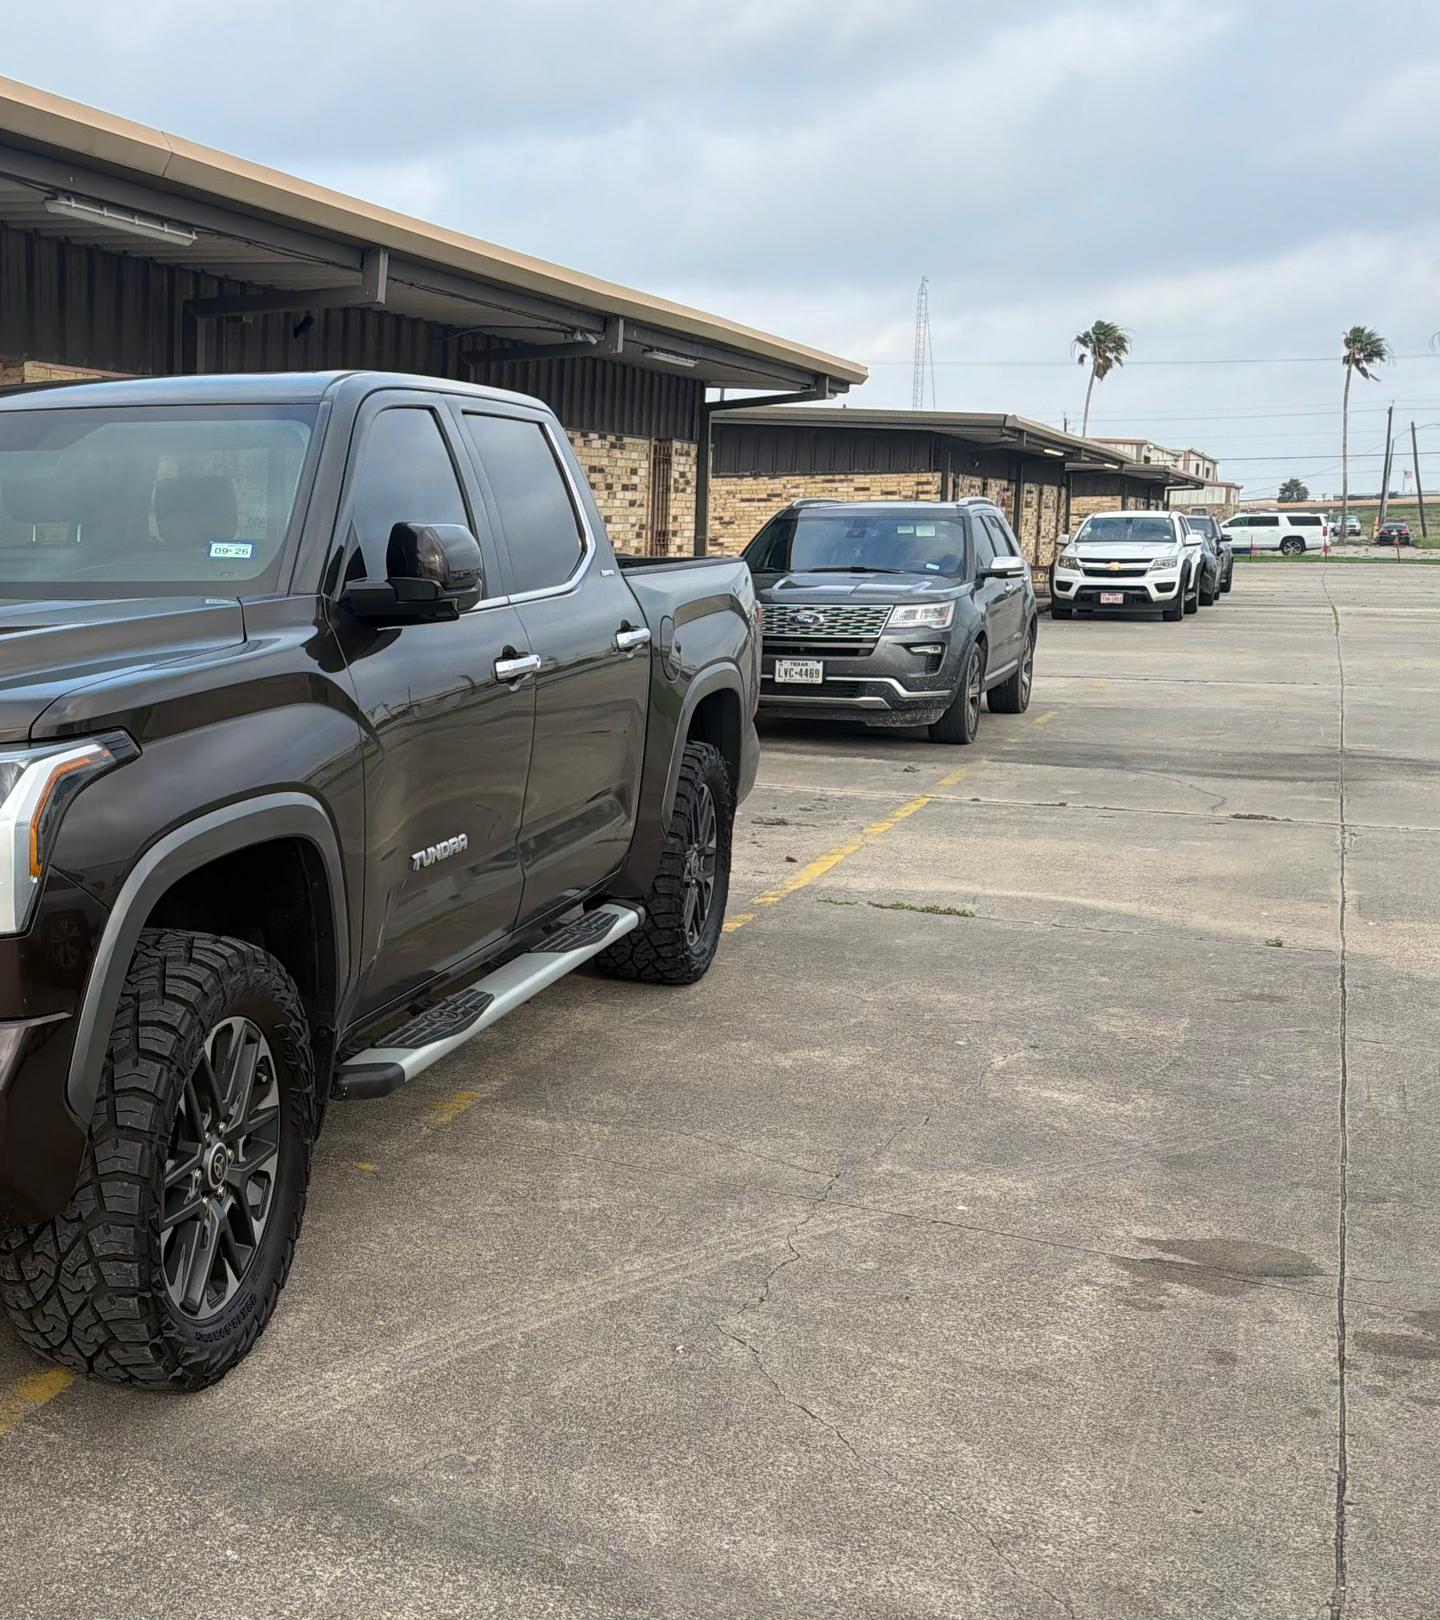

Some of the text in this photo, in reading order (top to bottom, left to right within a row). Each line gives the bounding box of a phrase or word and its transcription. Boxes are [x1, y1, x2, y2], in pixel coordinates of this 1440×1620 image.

[214, 547, 249, 555] 09 26
[411, 833, 468, 871] TUNDRA
